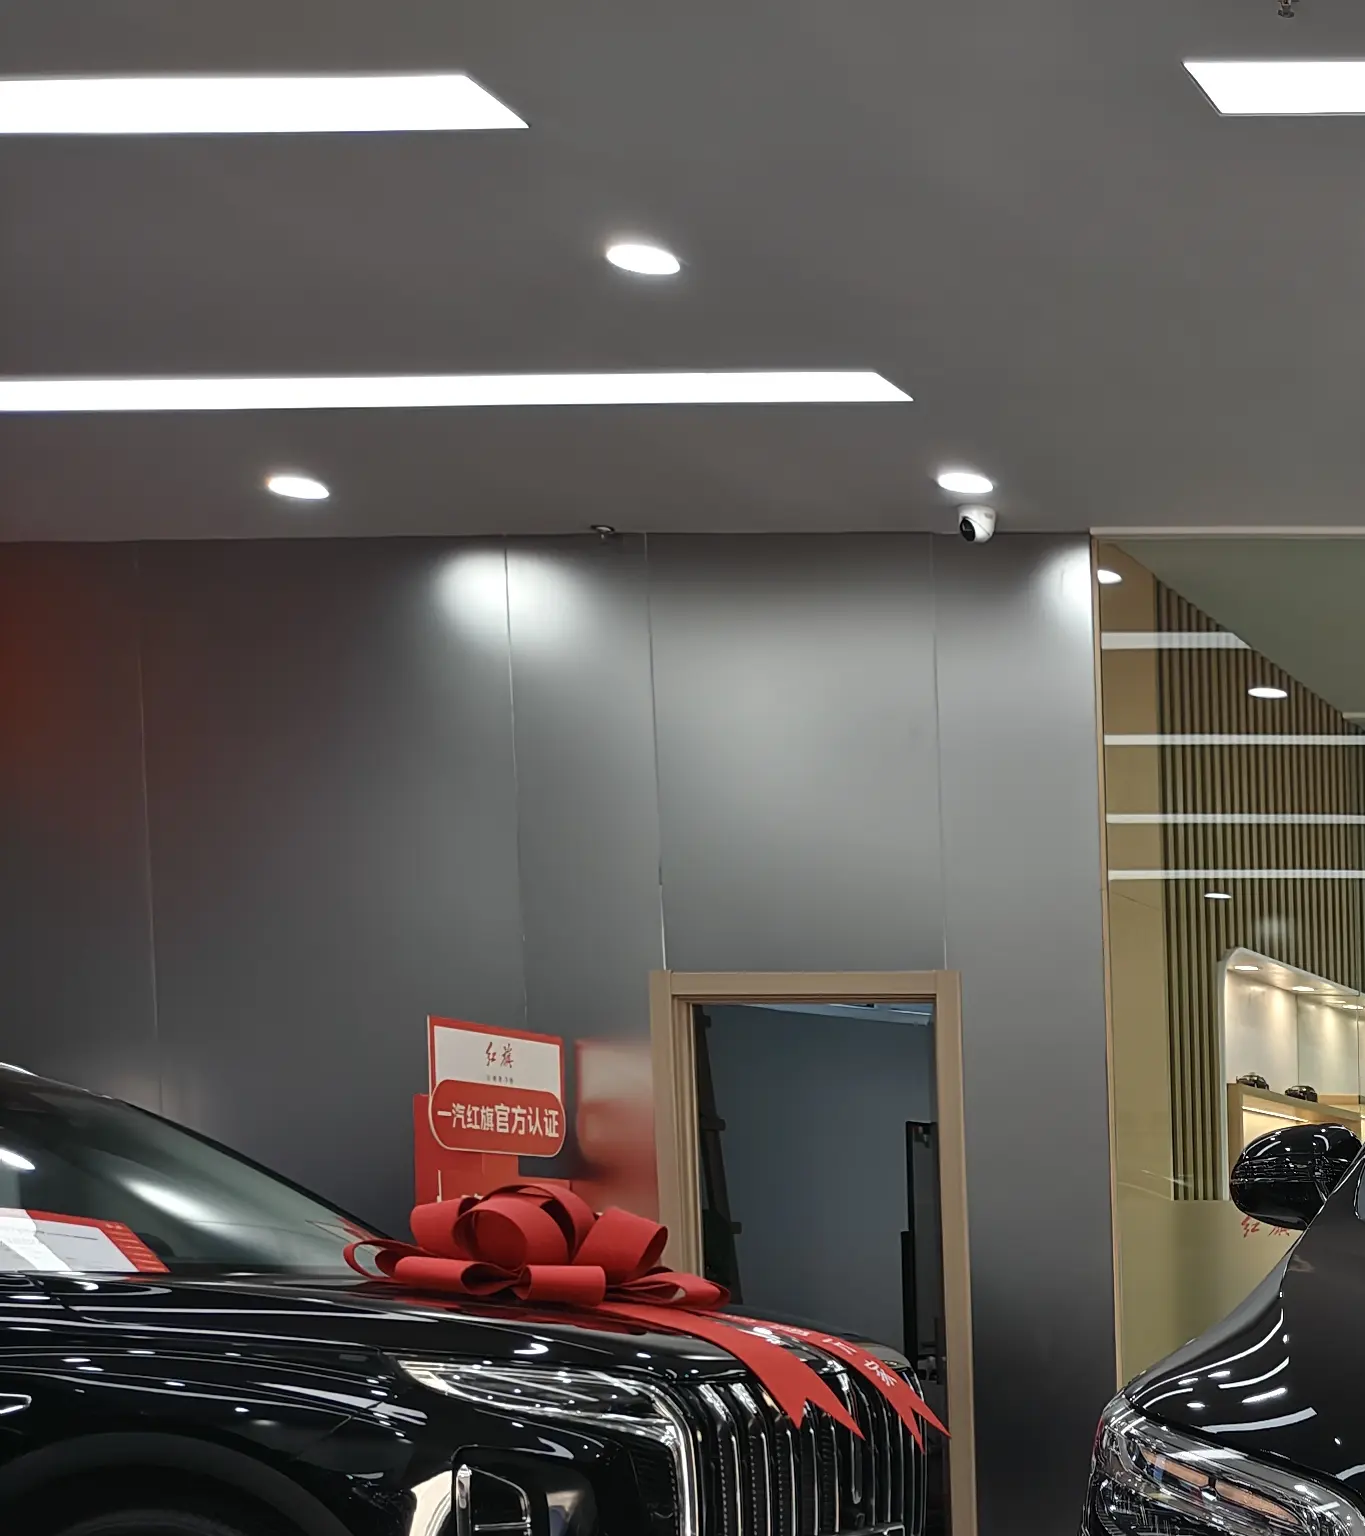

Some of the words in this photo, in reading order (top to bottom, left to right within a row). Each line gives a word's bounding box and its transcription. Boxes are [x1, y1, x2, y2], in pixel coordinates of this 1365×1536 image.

[485, 1041, 514, 1069] 红旗
[437, 1102, 560, 1138] 一汽红旗官方认证
